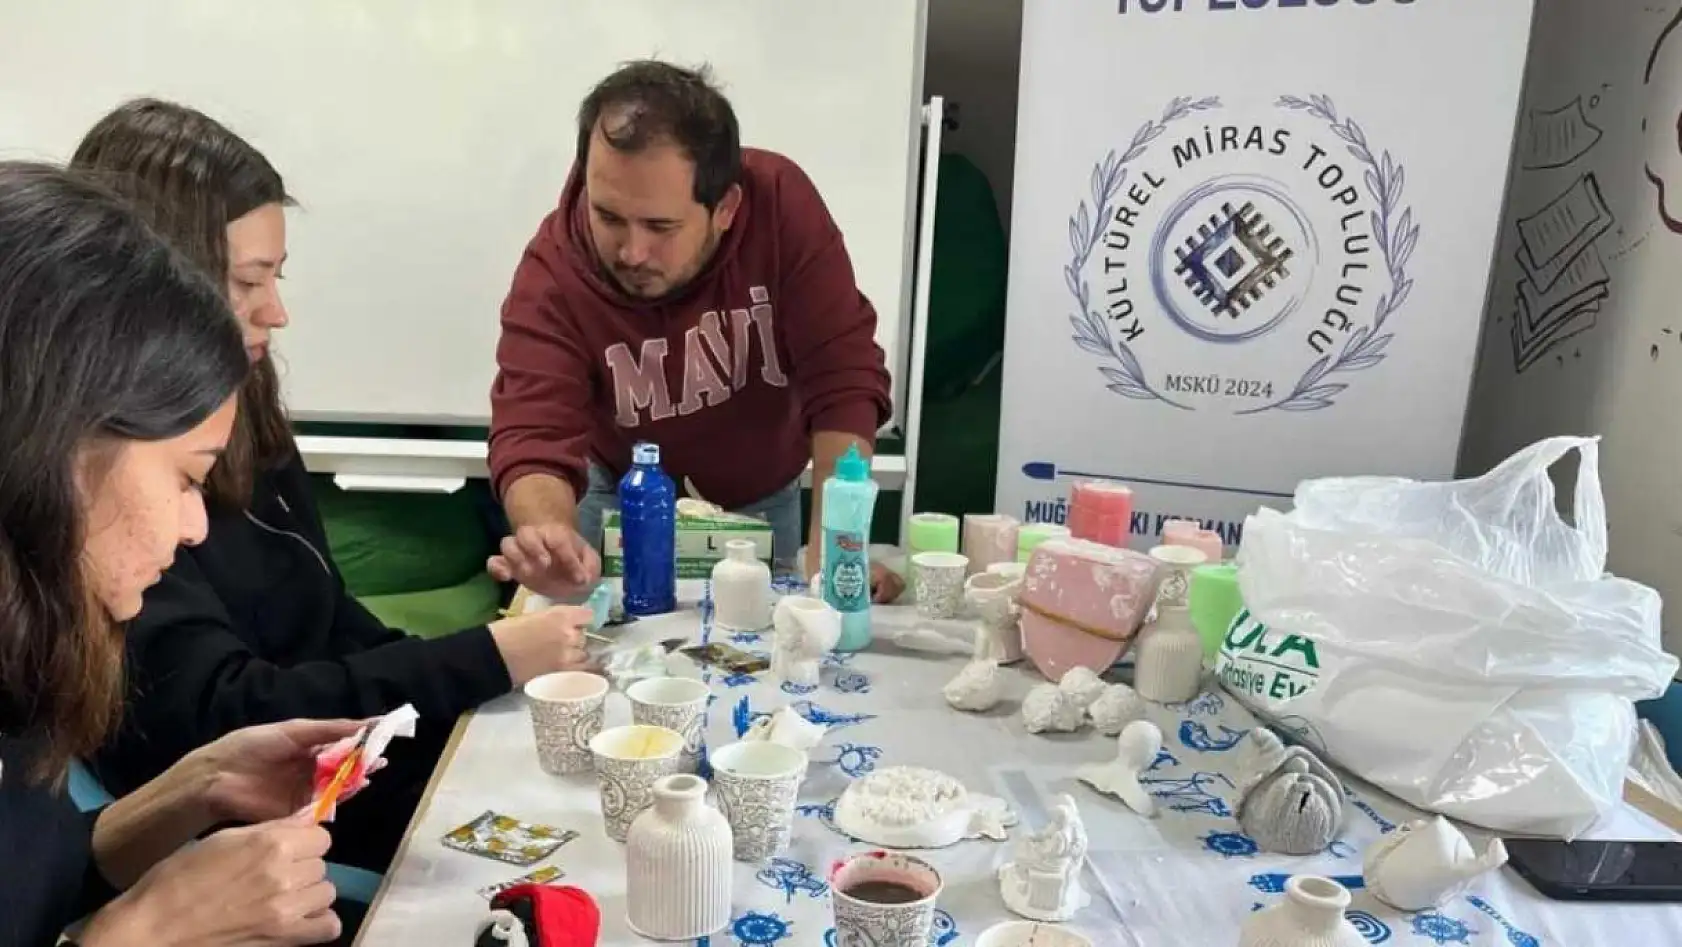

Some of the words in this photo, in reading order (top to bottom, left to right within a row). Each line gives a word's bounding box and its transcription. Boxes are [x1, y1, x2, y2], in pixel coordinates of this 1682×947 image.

[1104, 171, 1166, 341] KÜLTÜREL
[1171, 125, 1291, 168] MİRAS
[1303, 144, 1370, 354] TOPLULUĞU
[605, 286, 788, 427] MAVİ
[1165, 374, 1220, 394] MSKÜ
[1224, 378, 1275, 398] 2024
[1025, 497, 1069, 525] MUĞ
[707, 536, 718, 551] L
